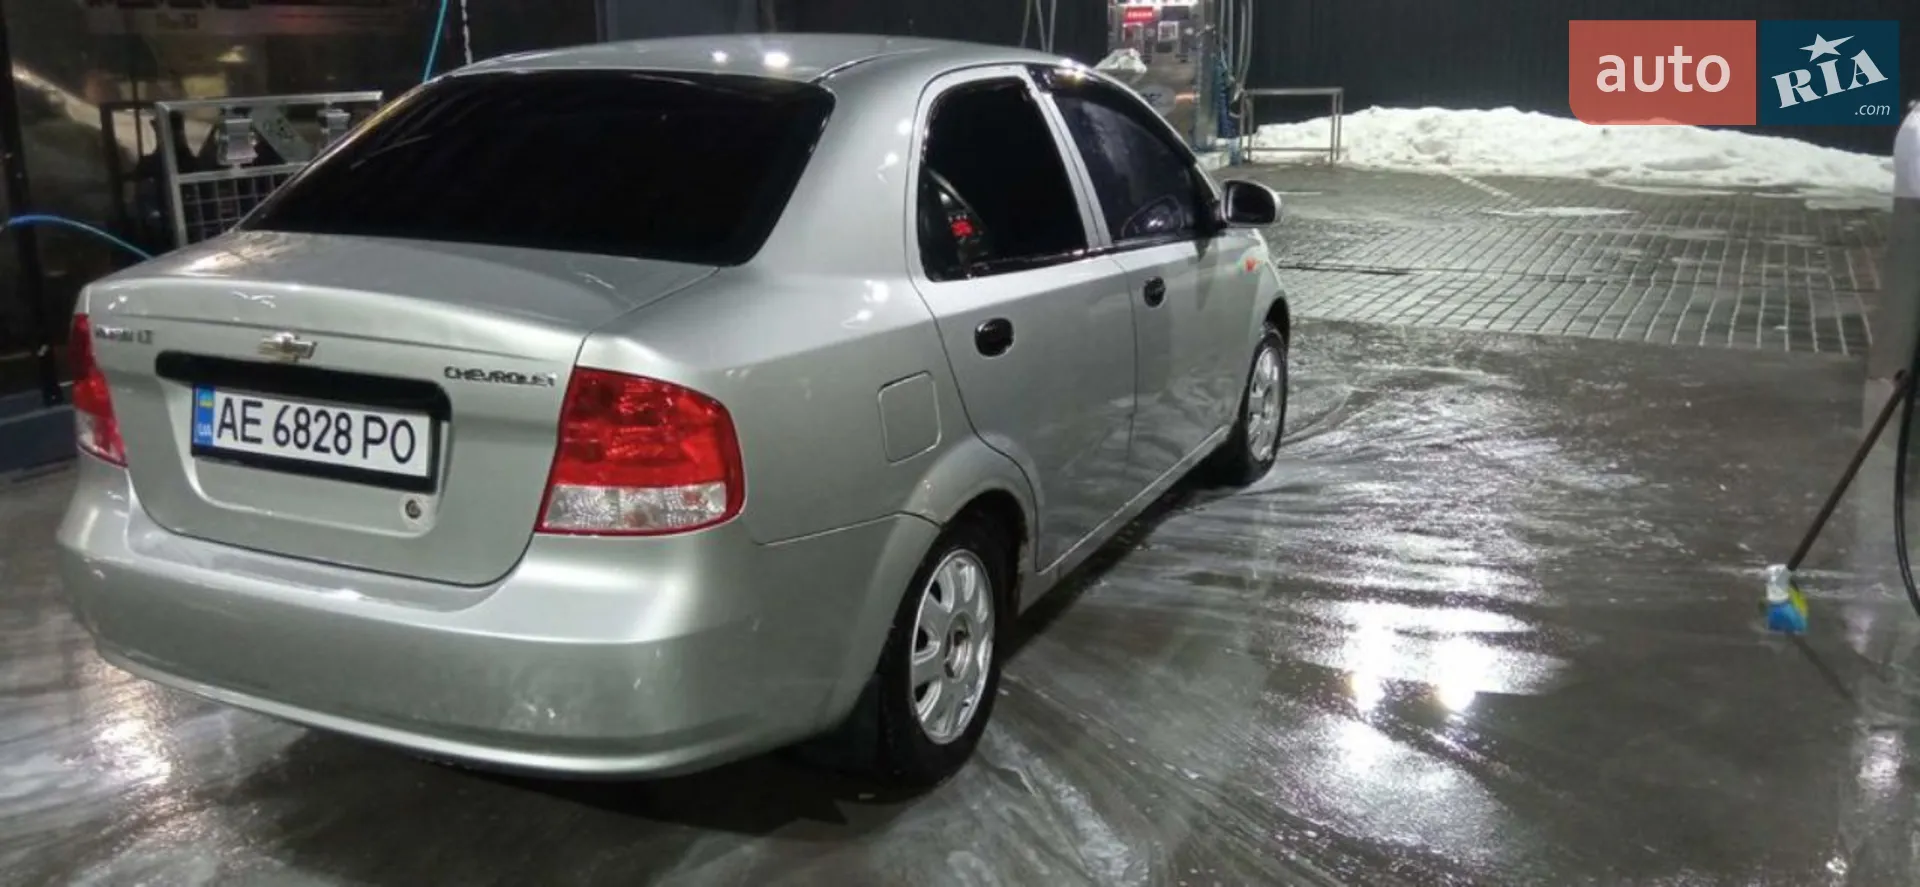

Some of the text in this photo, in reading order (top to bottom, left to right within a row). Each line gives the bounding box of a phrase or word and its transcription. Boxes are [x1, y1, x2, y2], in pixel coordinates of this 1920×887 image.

[217, 397, 416, 465] AE 6828 PO
